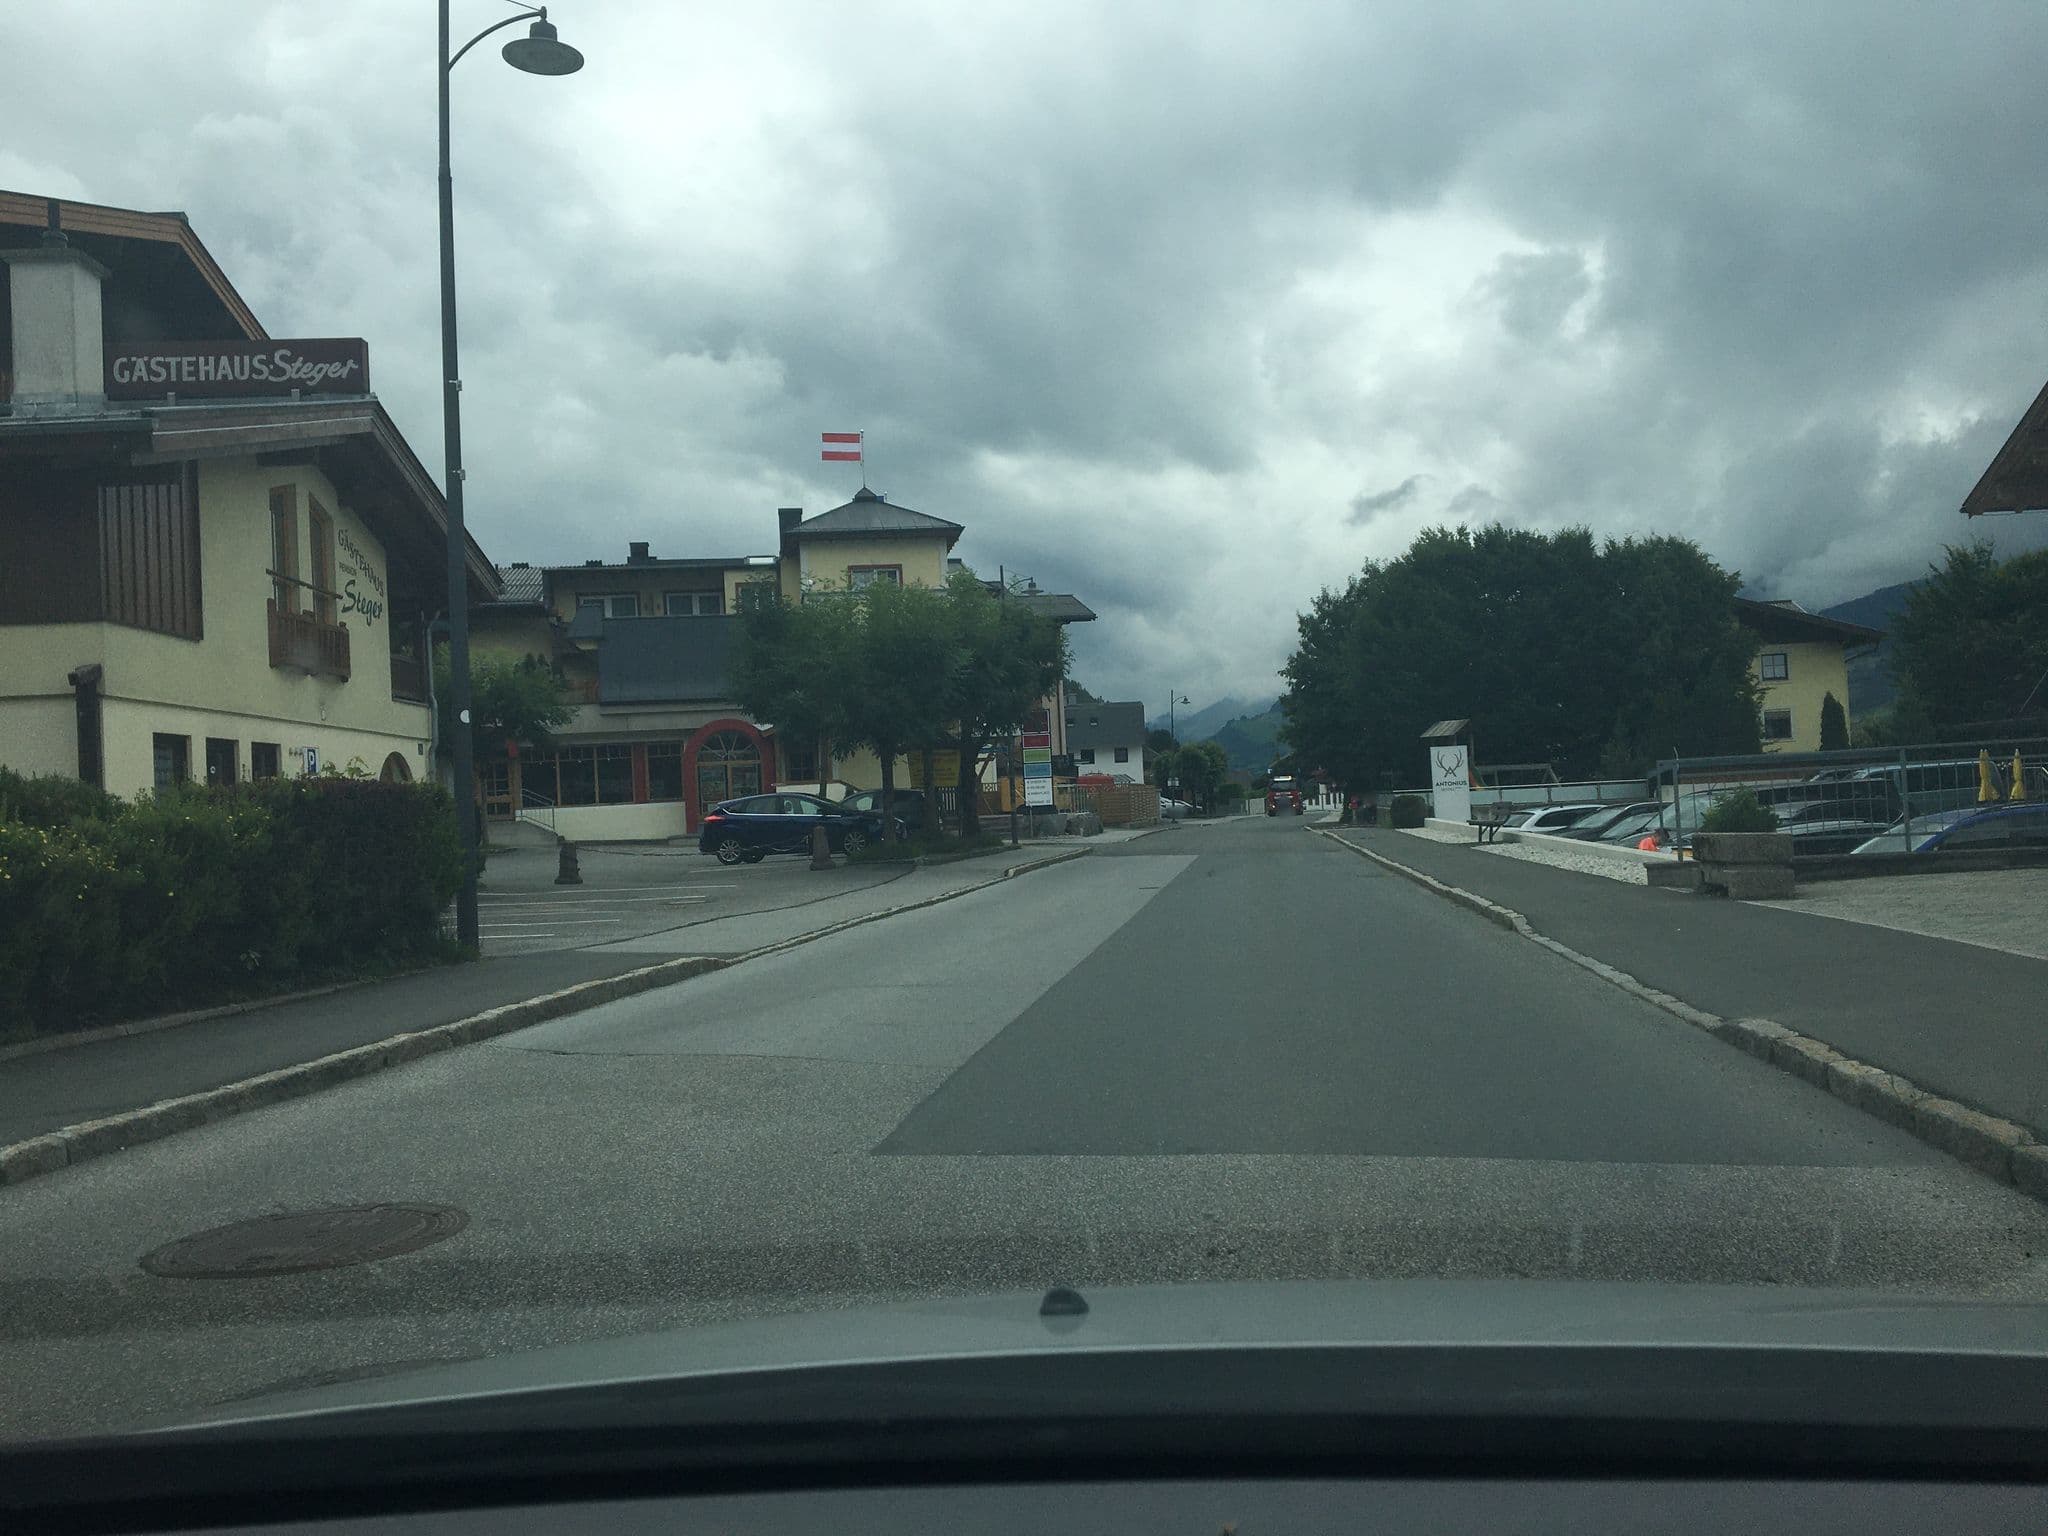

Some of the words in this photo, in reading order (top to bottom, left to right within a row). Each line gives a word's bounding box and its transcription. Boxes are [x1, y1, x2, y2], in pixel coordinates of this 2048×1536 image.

[113, 356, 270, 383] GÄSTEHAUS
[268, 349, 359, 386] Steger
[341, 579, 382, 627] Steger
